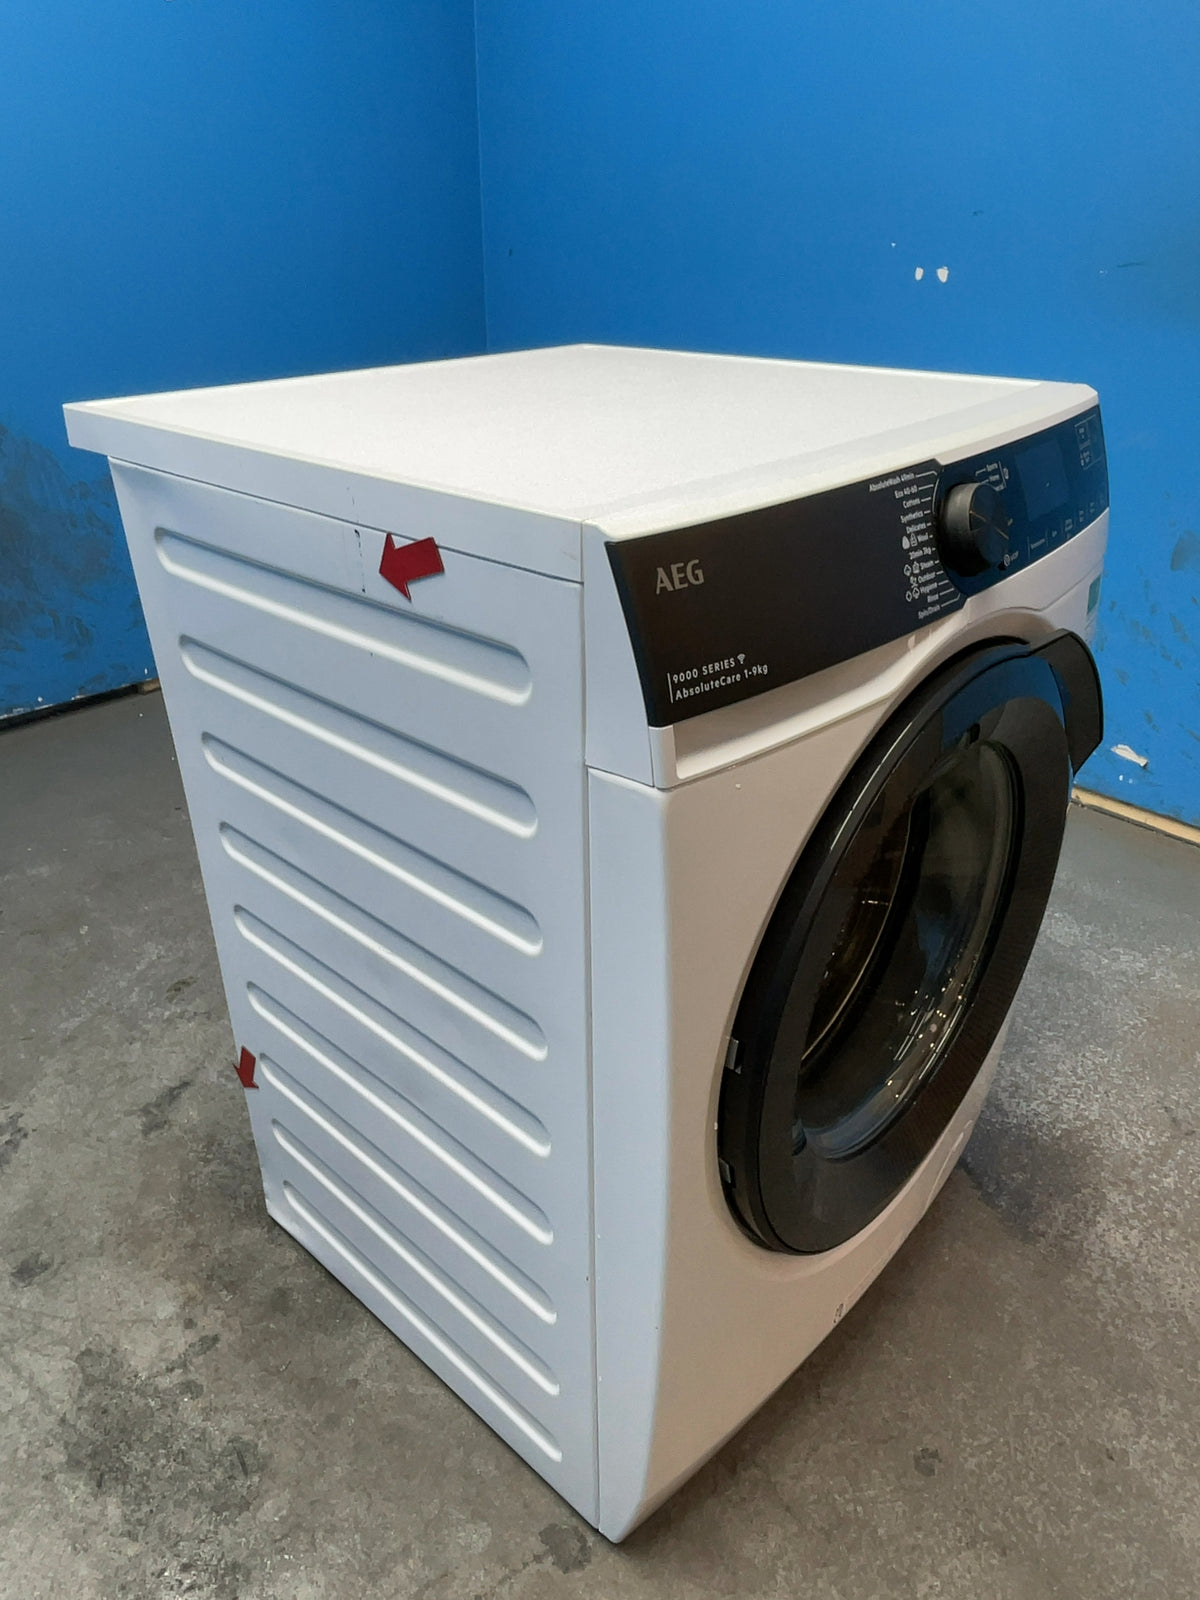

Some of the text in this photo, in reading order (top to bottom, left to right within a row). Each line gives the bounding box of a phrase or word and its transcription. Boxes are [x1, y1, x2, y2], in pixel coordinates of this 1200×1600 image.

[894, 485, 918, 498] Eco 40-60
[902, 498, 920, 508] Cottons
[900, 510, 924, 524] Synthetics
[906, 522, 926, 534] Delicates
[656, 559, 704, 595] AEG
[672, 658, 735, 684] 9000 SERIES
[675, 664, 768, 701] AbsoluteCare 1-9kg
